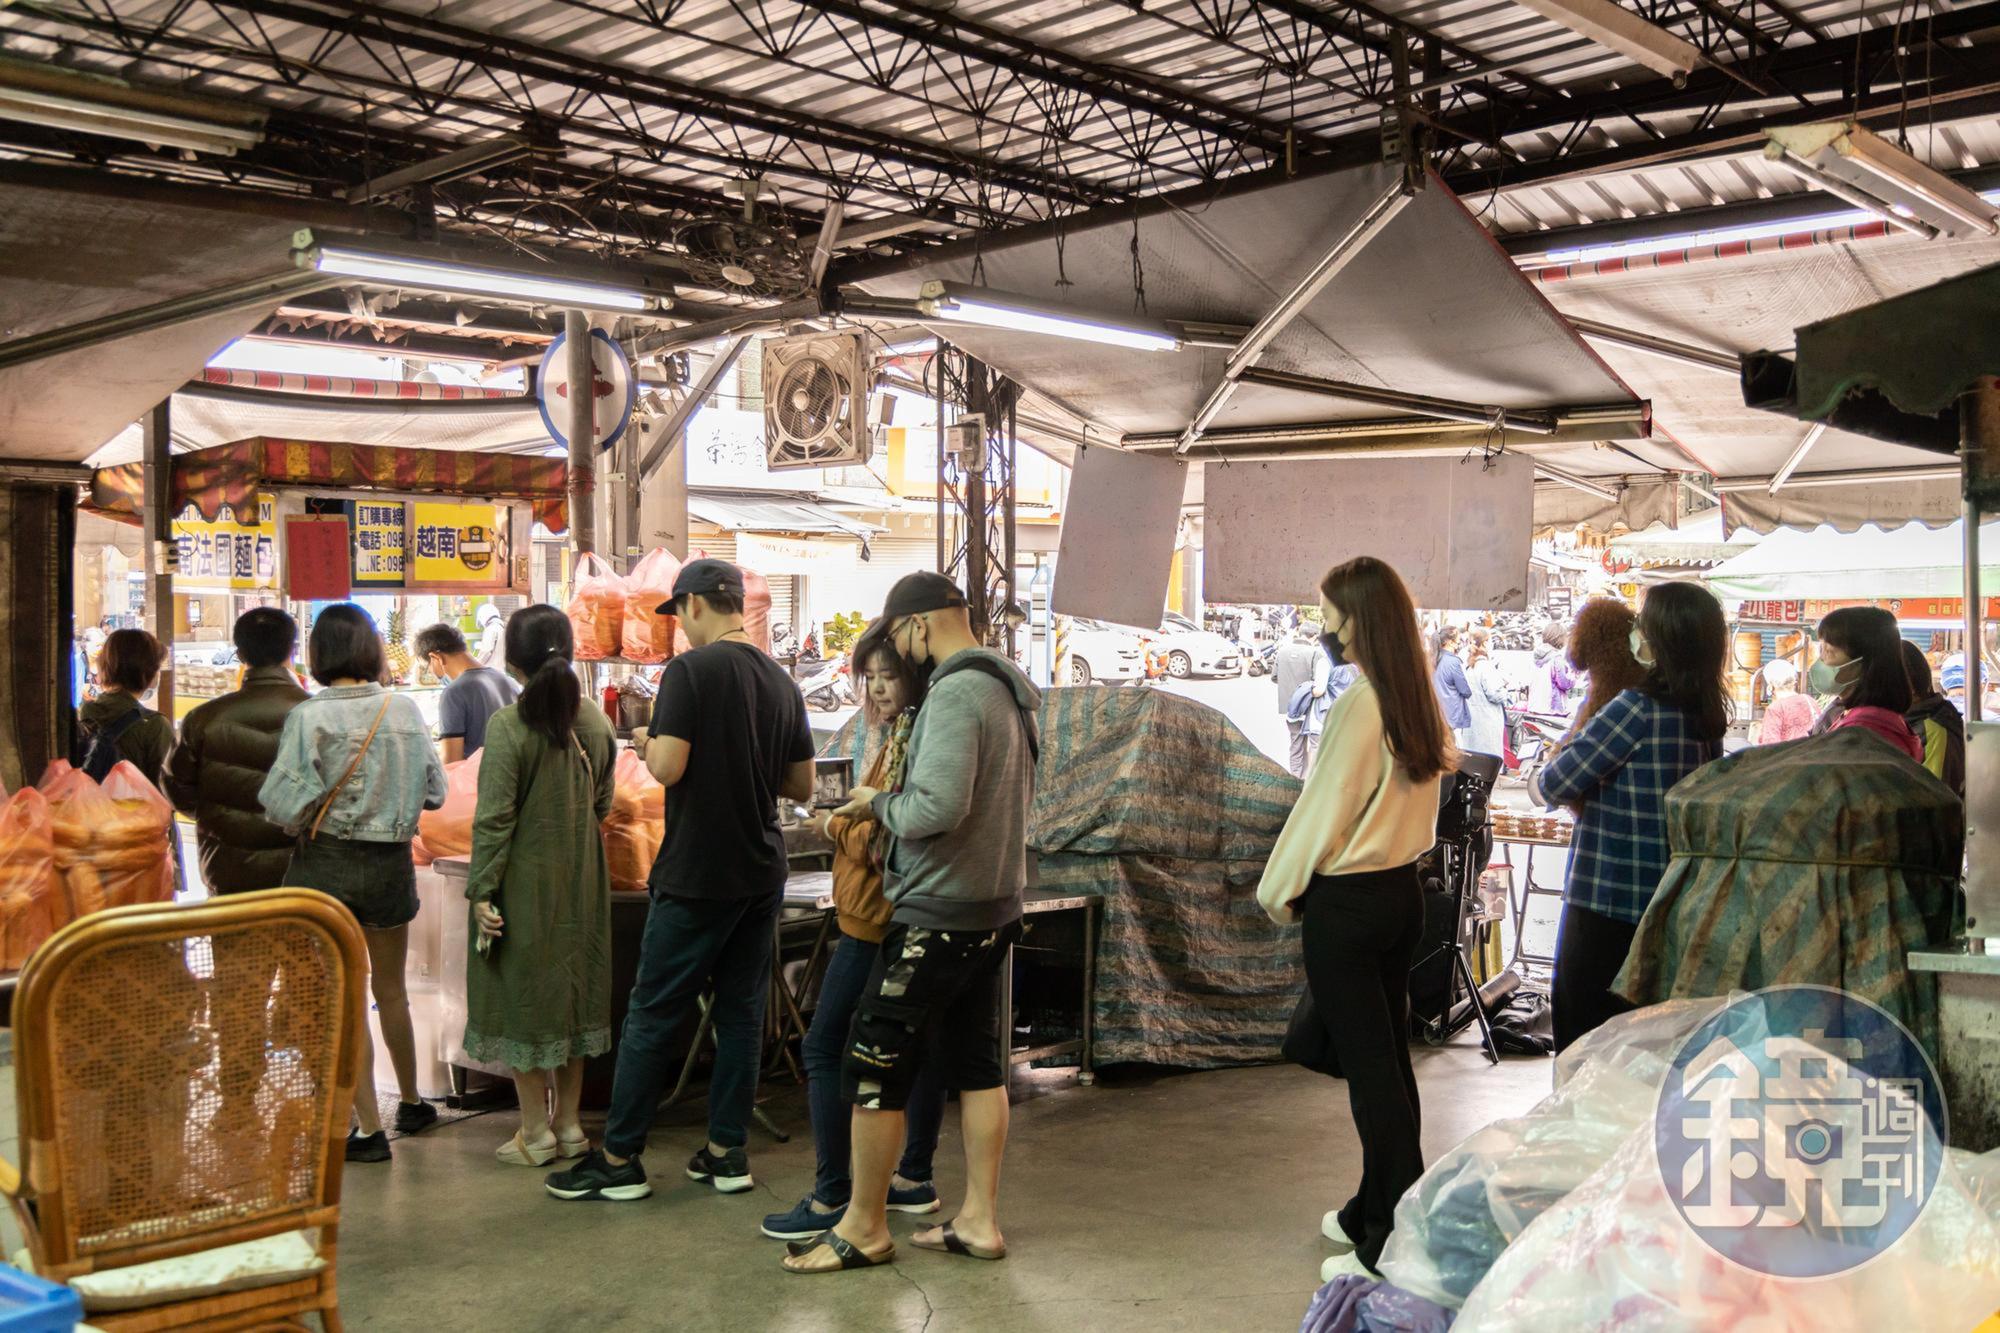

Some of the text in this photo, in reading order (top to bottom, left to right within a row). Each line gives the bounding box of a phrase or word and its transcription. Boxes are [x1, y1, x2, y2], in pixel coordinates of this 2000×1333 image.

[359, 506, 406, 526] 訂購專線
[361, 556, 407, 572] NE:098
